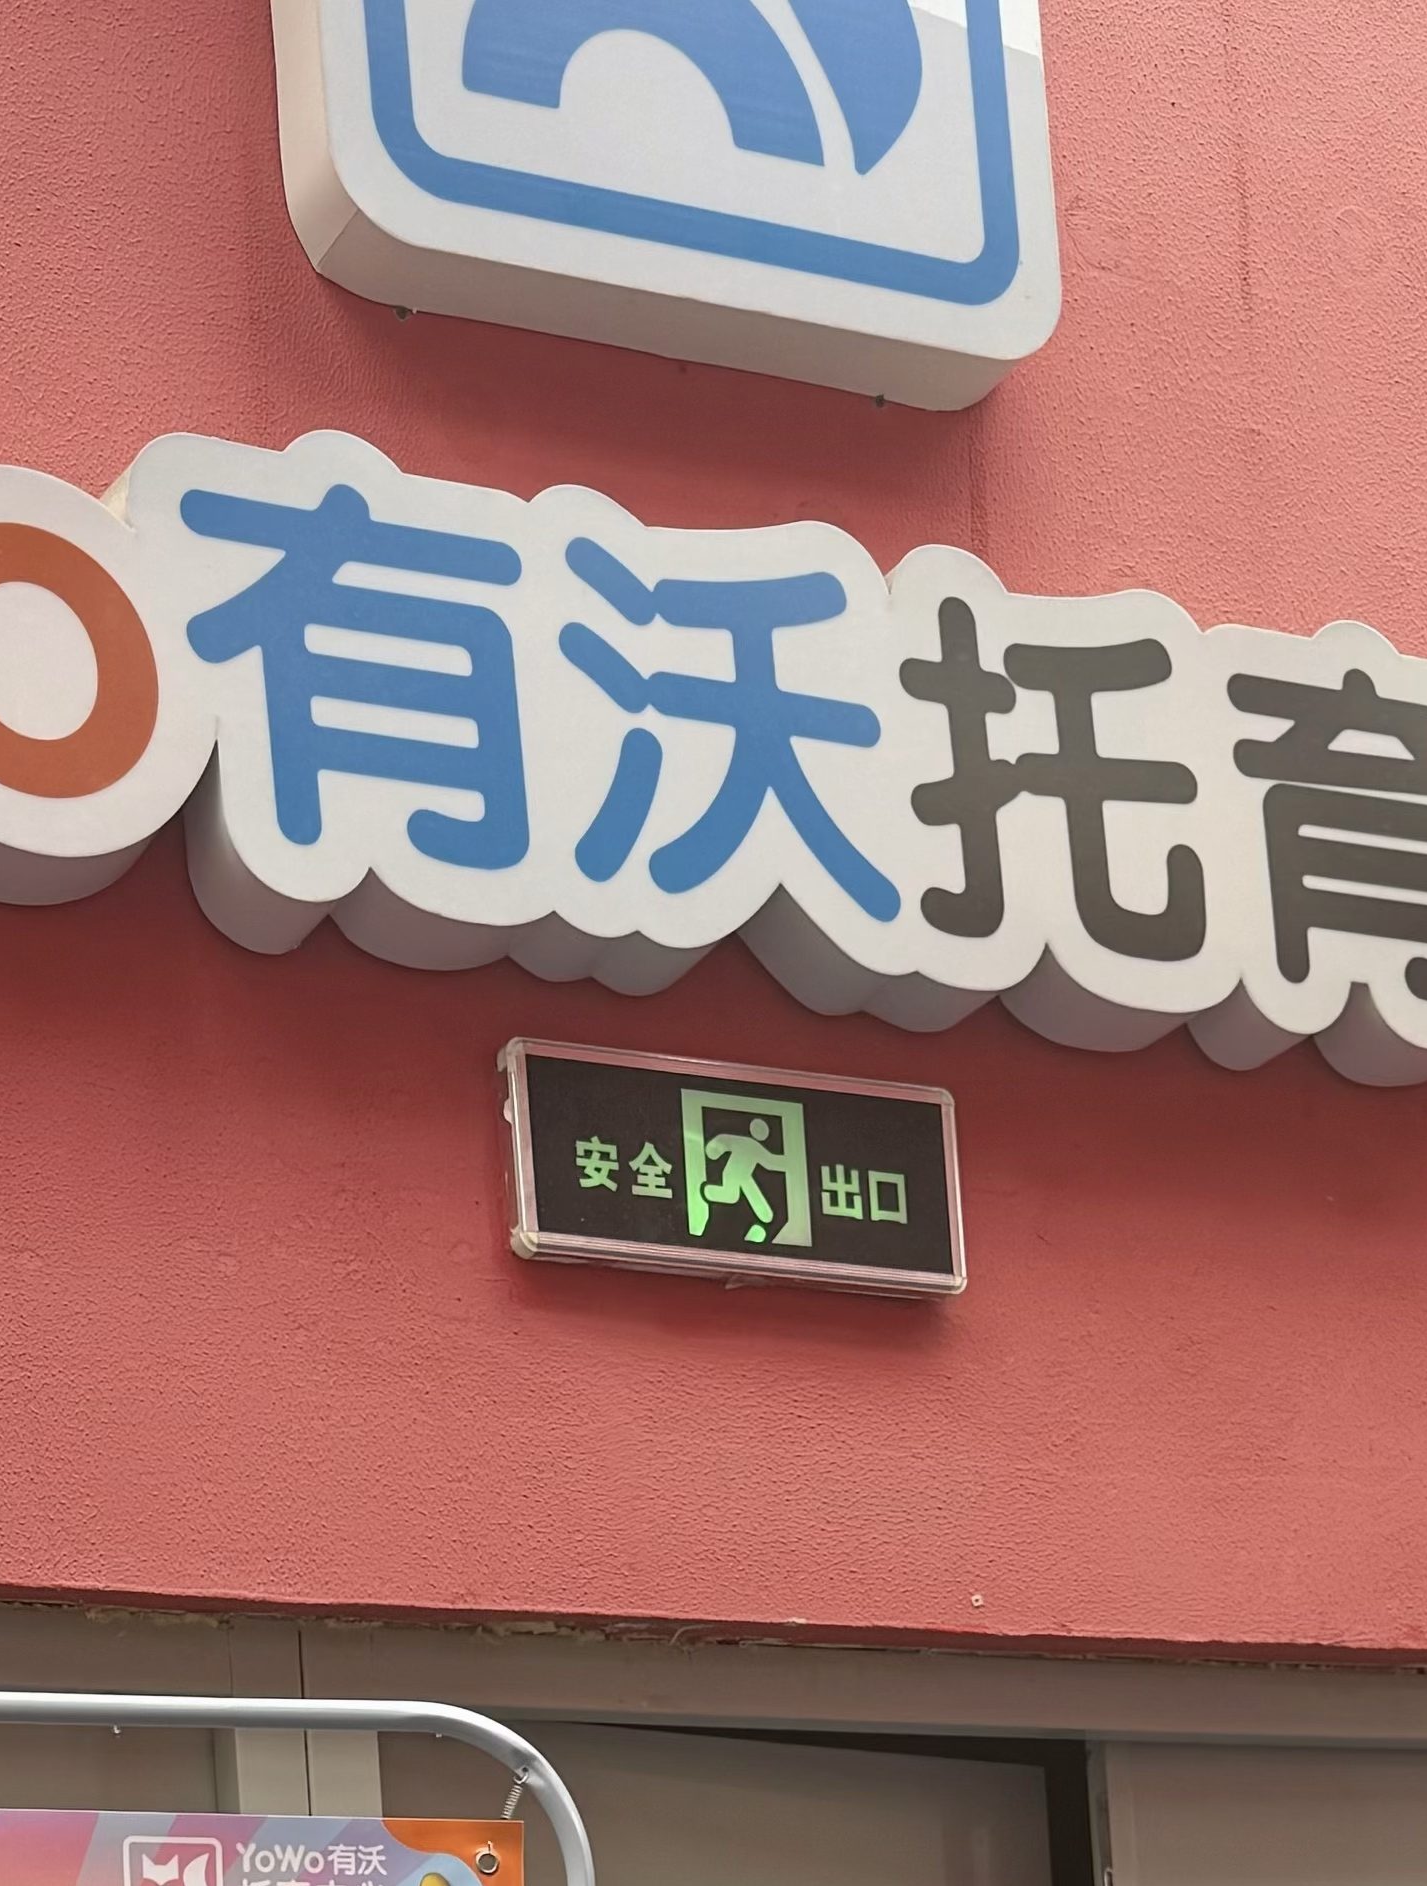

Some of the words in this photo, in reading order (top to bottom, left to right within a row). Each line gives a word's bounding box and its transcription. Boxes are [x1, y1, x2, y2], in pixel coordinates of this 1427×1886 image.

[575, 1135, 673, 1200] 安全
[820, 1163, 908, 1225] 出口
[328, 1844, 387, 1876] 有沃
